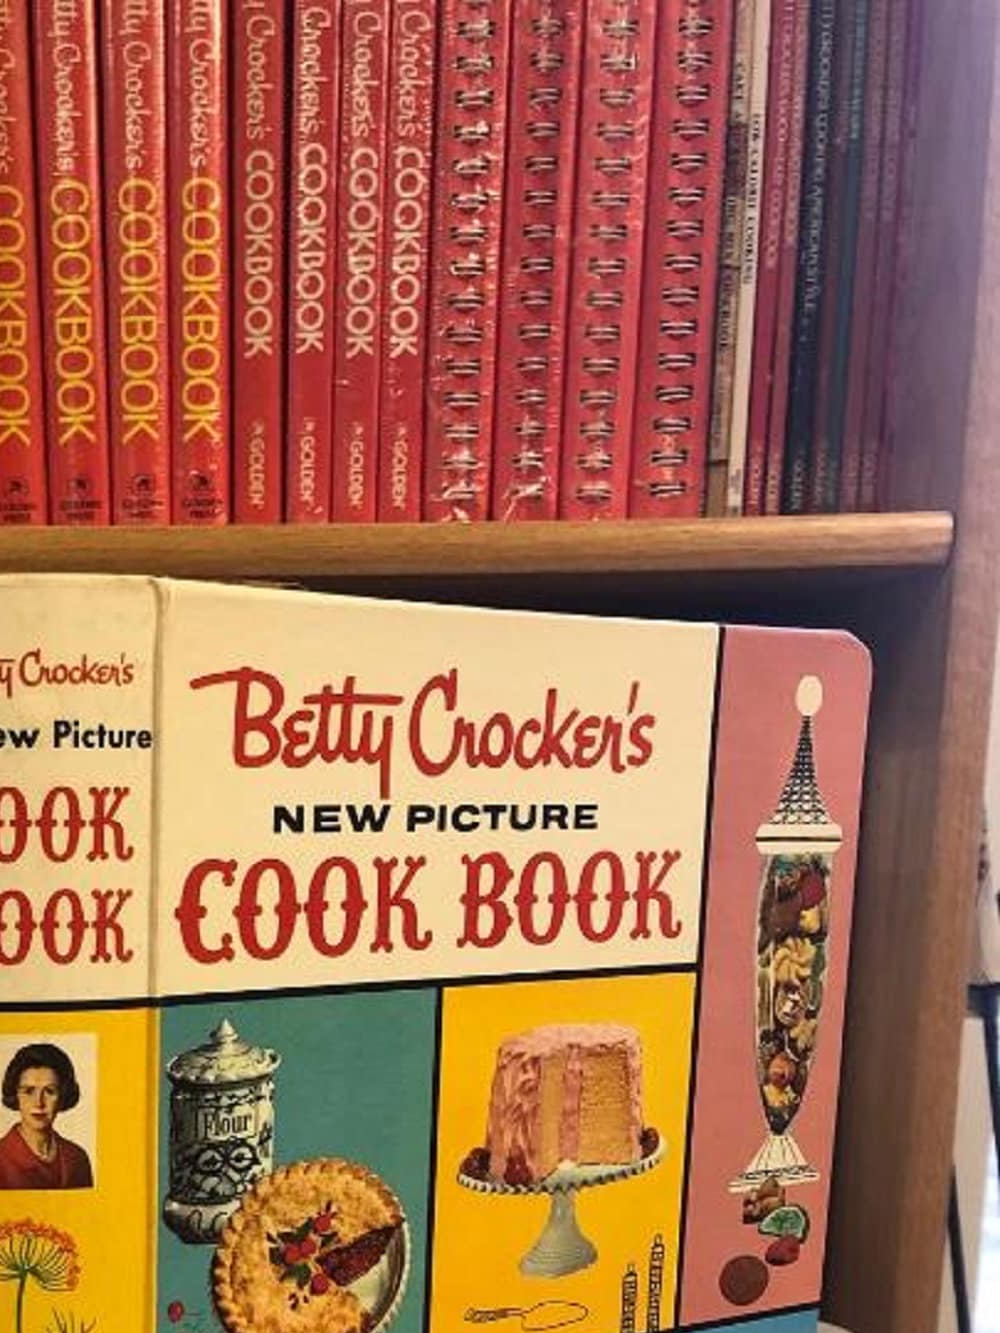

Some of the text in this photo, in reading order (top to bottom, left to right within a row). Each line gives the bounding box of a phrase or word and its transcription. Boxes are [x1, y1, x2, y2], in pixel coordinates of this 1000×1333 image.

[50, 178, 97, 447] COOKBOOK
[118, 177, 161, 446] COOKBOOK
[181, 177, 222, 444] COOKBOOK
[244, 150, 275, 359] COOKBOOK
[295, 143, 327, 354] COOKBOOK
[346, 148, 378, 359] COOKBOOK
[389, 147, 426, 359] COOKBOOK
[18, 648, 135, 688] Crocker's
[51, 719, 154, 751] Picture
[189, 667, 657, 799] Betty Crocker's
[174, 850, 683, 965] COOK BOOK
[272, 802, 600, 834] NEW PICTURE
[203, 1112, 254, 1138] Flour
